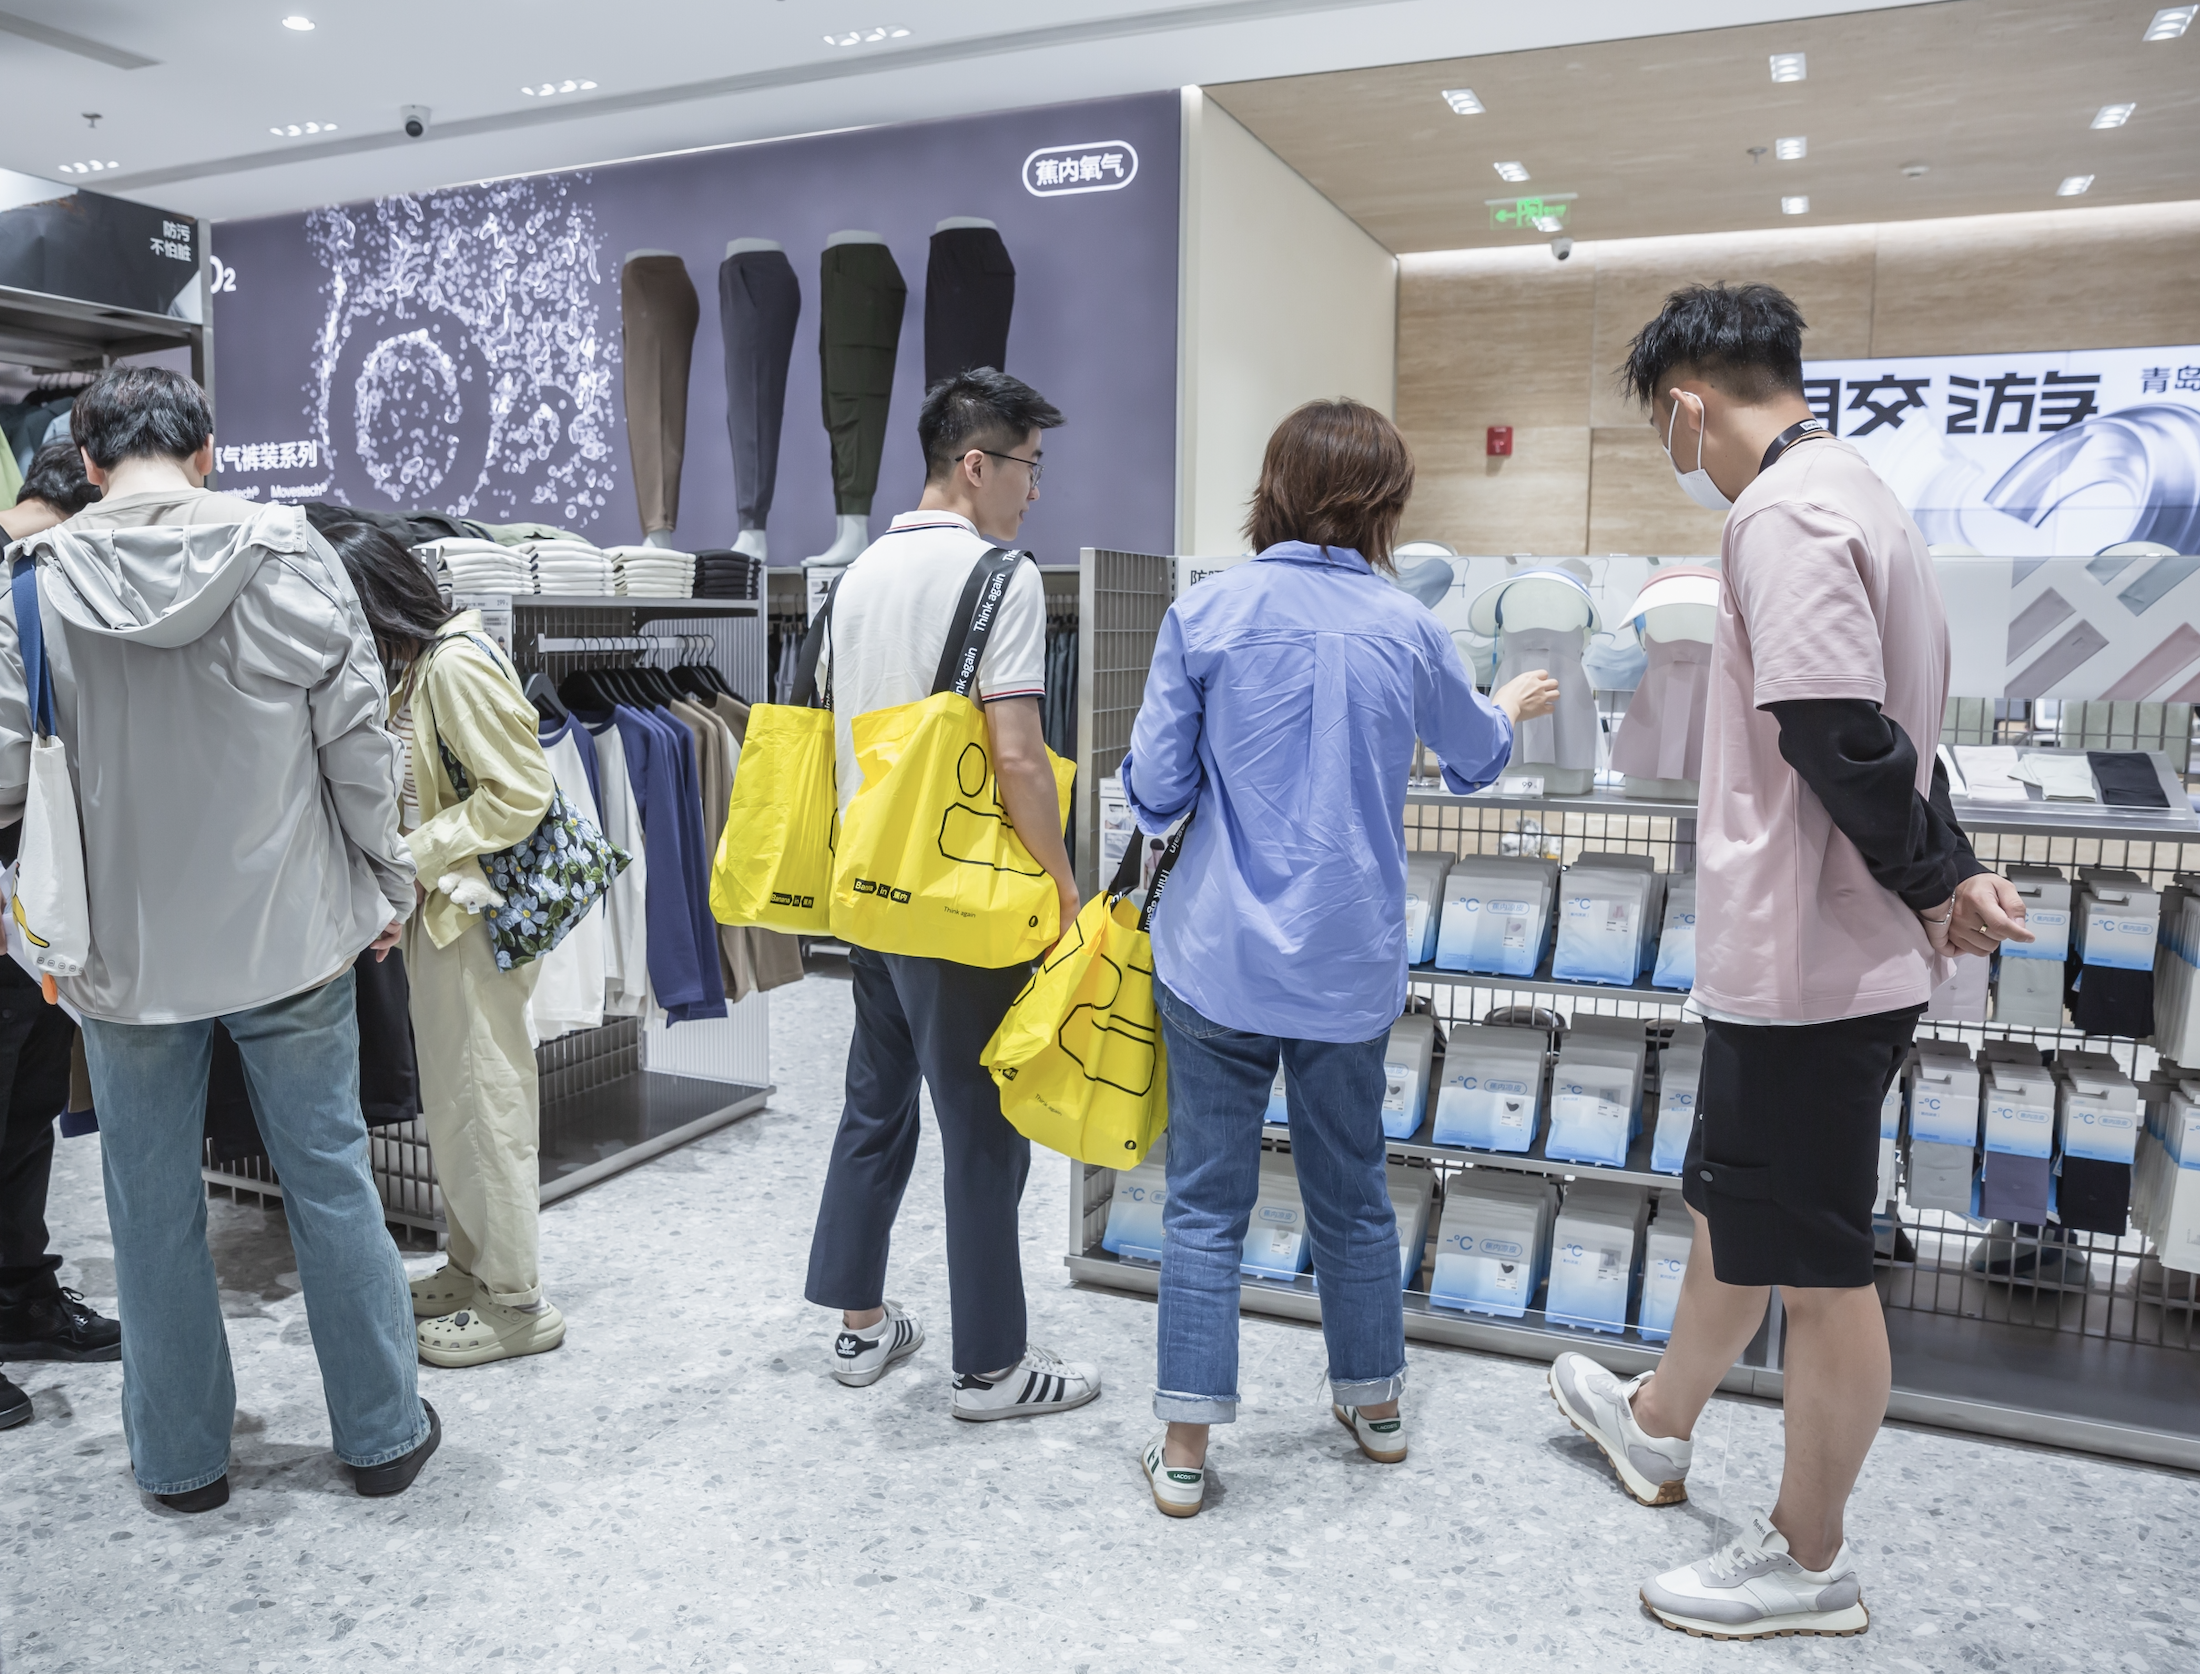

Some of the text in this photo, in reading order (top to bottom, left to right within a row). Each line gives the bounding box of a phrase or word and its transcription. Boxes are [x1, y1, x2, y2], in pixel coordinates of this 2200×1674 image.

[1035, 153, 1124, 186] 蕉内氧气
[163, 220, 190, 242] 防污
[150, 237, 192, 262] 不怕脏
[973, 573, 1006, 632] Think again
[960, 647, 978, 677] again
[944, 905, 959, 915] Think
